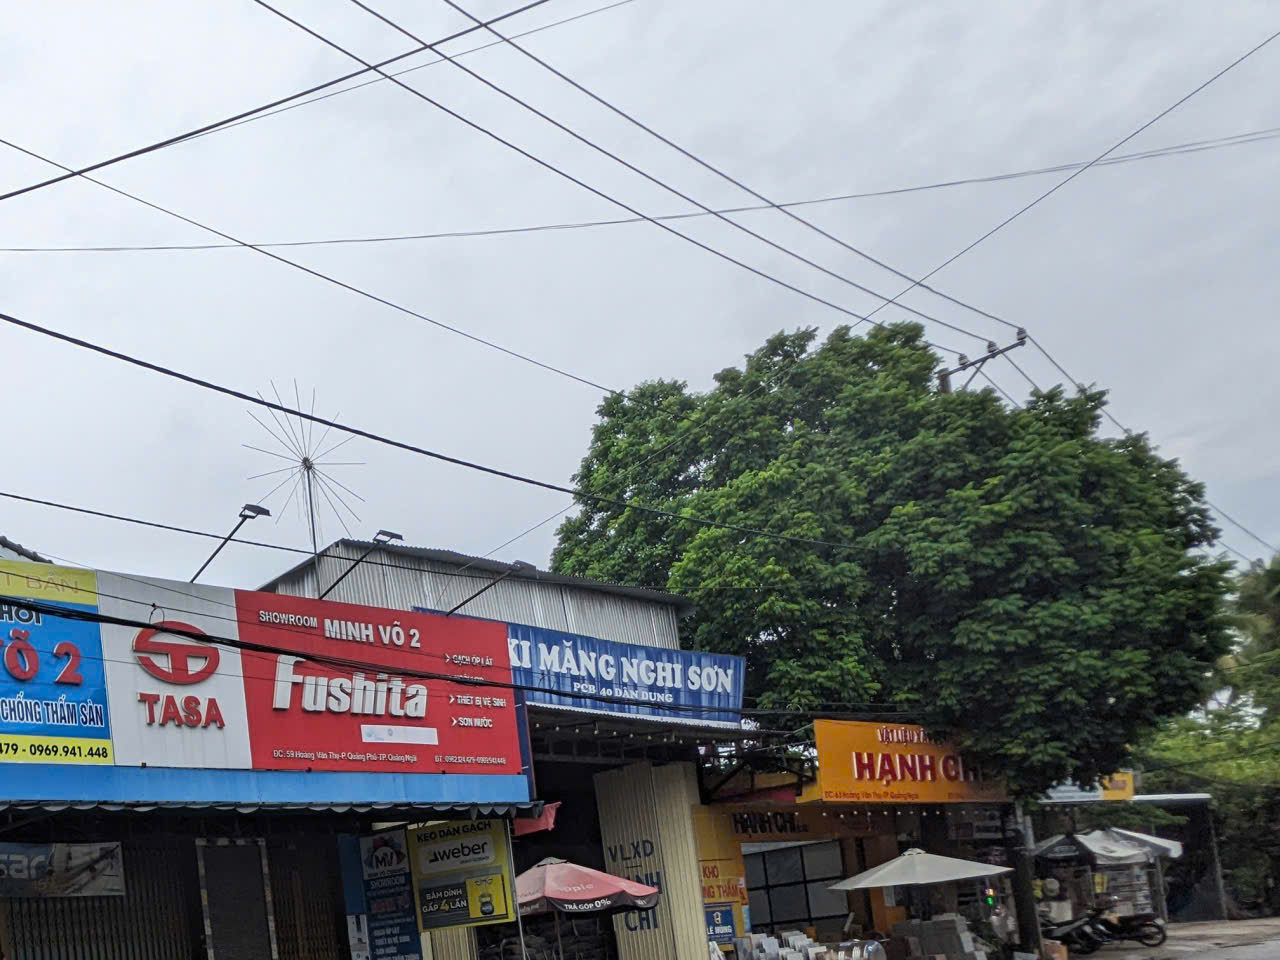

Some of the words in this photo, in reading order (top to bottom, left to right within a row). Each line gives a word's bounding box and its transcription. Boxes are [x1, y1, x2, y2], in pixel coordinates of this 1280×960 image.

[259, 610, 318, 629] SHOWROOM
[324, 618, 375, 643] MINH
[378, 621, 405, 646] VÕ
[408, 628, 421, 649] 2
[53, 641, 83, 685] 2
[538, 639, 617, 682] MĂNG
[621, 656, 683, 689] NGHI
[687, 664, 734, 694] SƠN
[271, 653, 429, 720] Fushita
[573, 681, 597, 695] PCB
[599, 688, 613, 697] 40
[614, 686, 639, 699] DÂN
[0, 691, 43, 725] CHỐNG
[43, 694, 79, 726] THẤM
[79, 698, 105, 728] SÀN
[136, 691, 226, 730] TASA
[29, 744, 109, 759] 0969.941.448
[852, 750, 937, 787] HẠNH
[438, 841, 489, 861] weber
[608, 839, 655, 863] VLXD
[702, 865, 719, 879] KHO
[440, 899, 450, 912] 4
[594, 898, 612, 909] 0%
[625, 908, 658, 933] CHI
